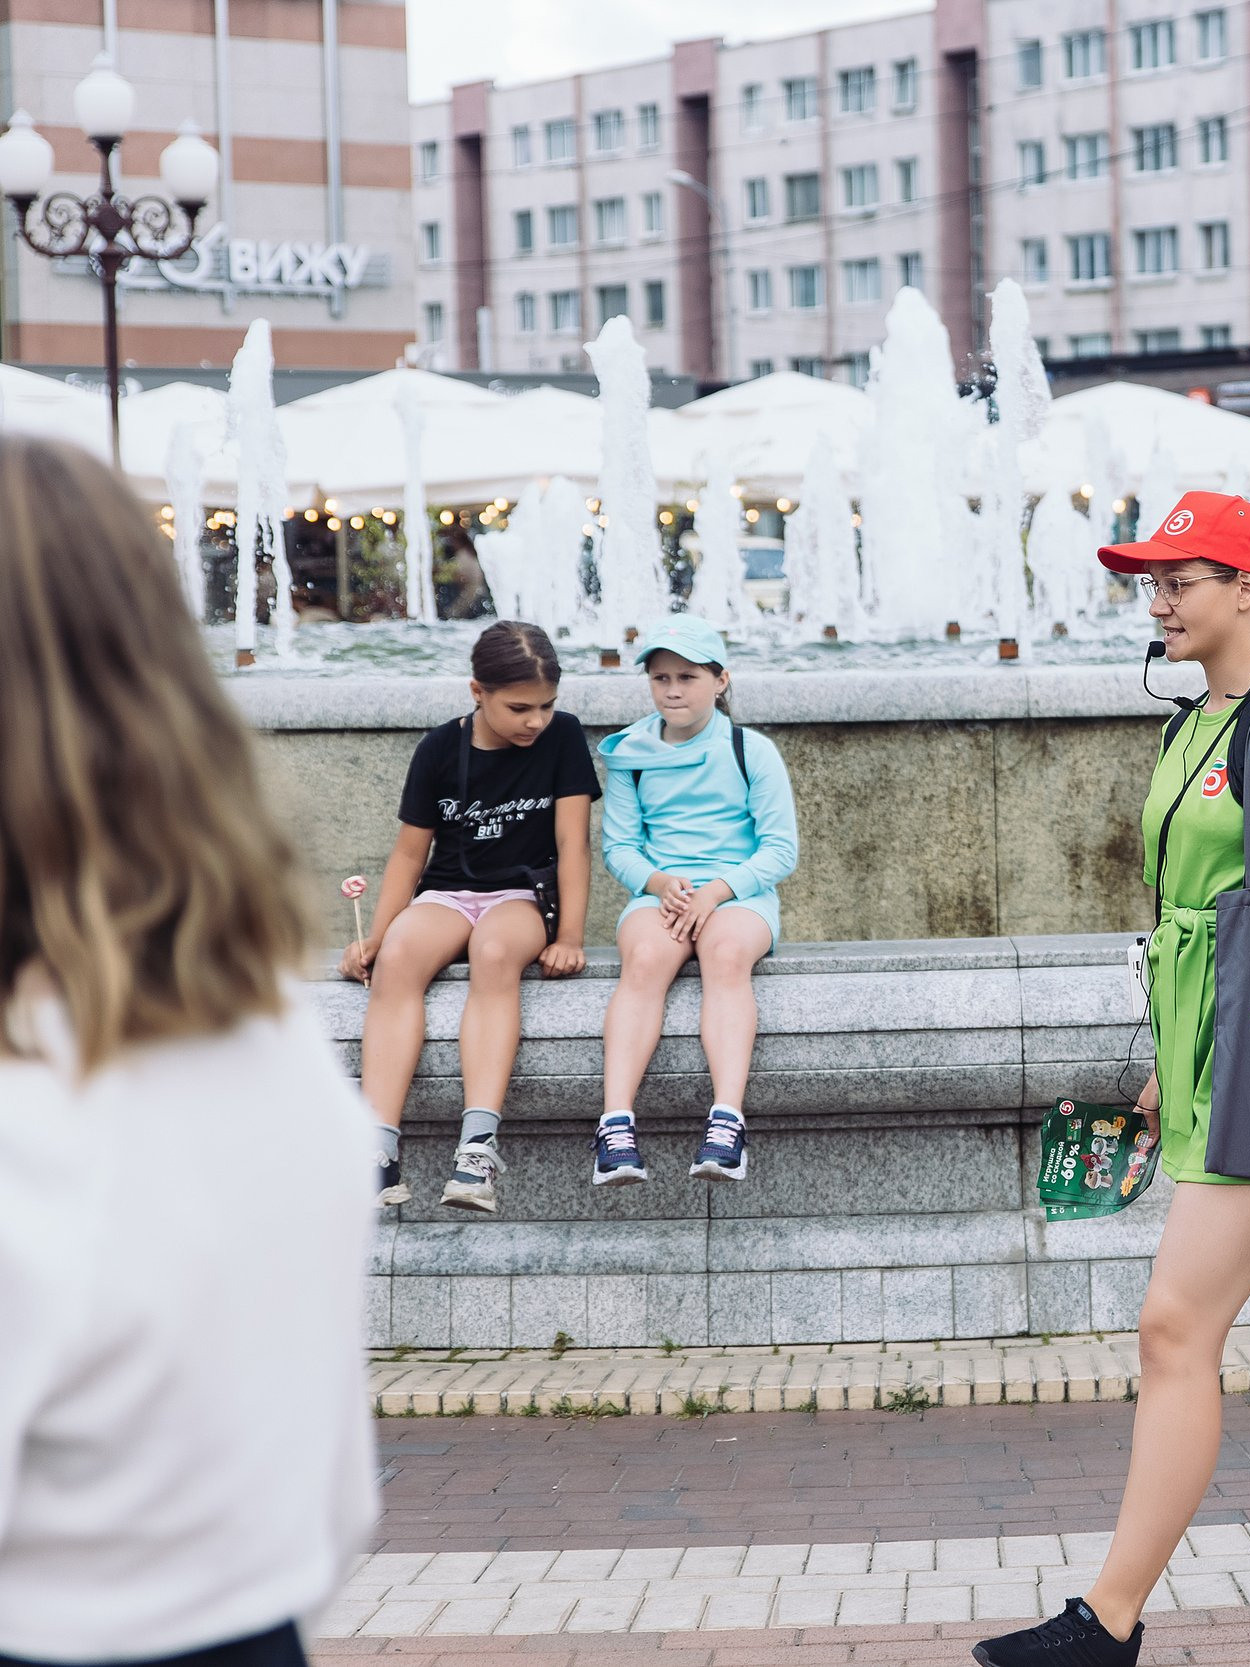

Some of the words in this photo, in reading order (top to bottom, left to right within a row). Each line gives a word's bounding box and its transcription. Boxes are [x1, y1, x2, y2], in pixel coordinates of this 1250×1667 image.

[228, 239, 370, 288] ВИЖУ
[1043, 1148, 1056, 1182] Игрушка
[1053, 1141, 1065, 1174] скидкой
